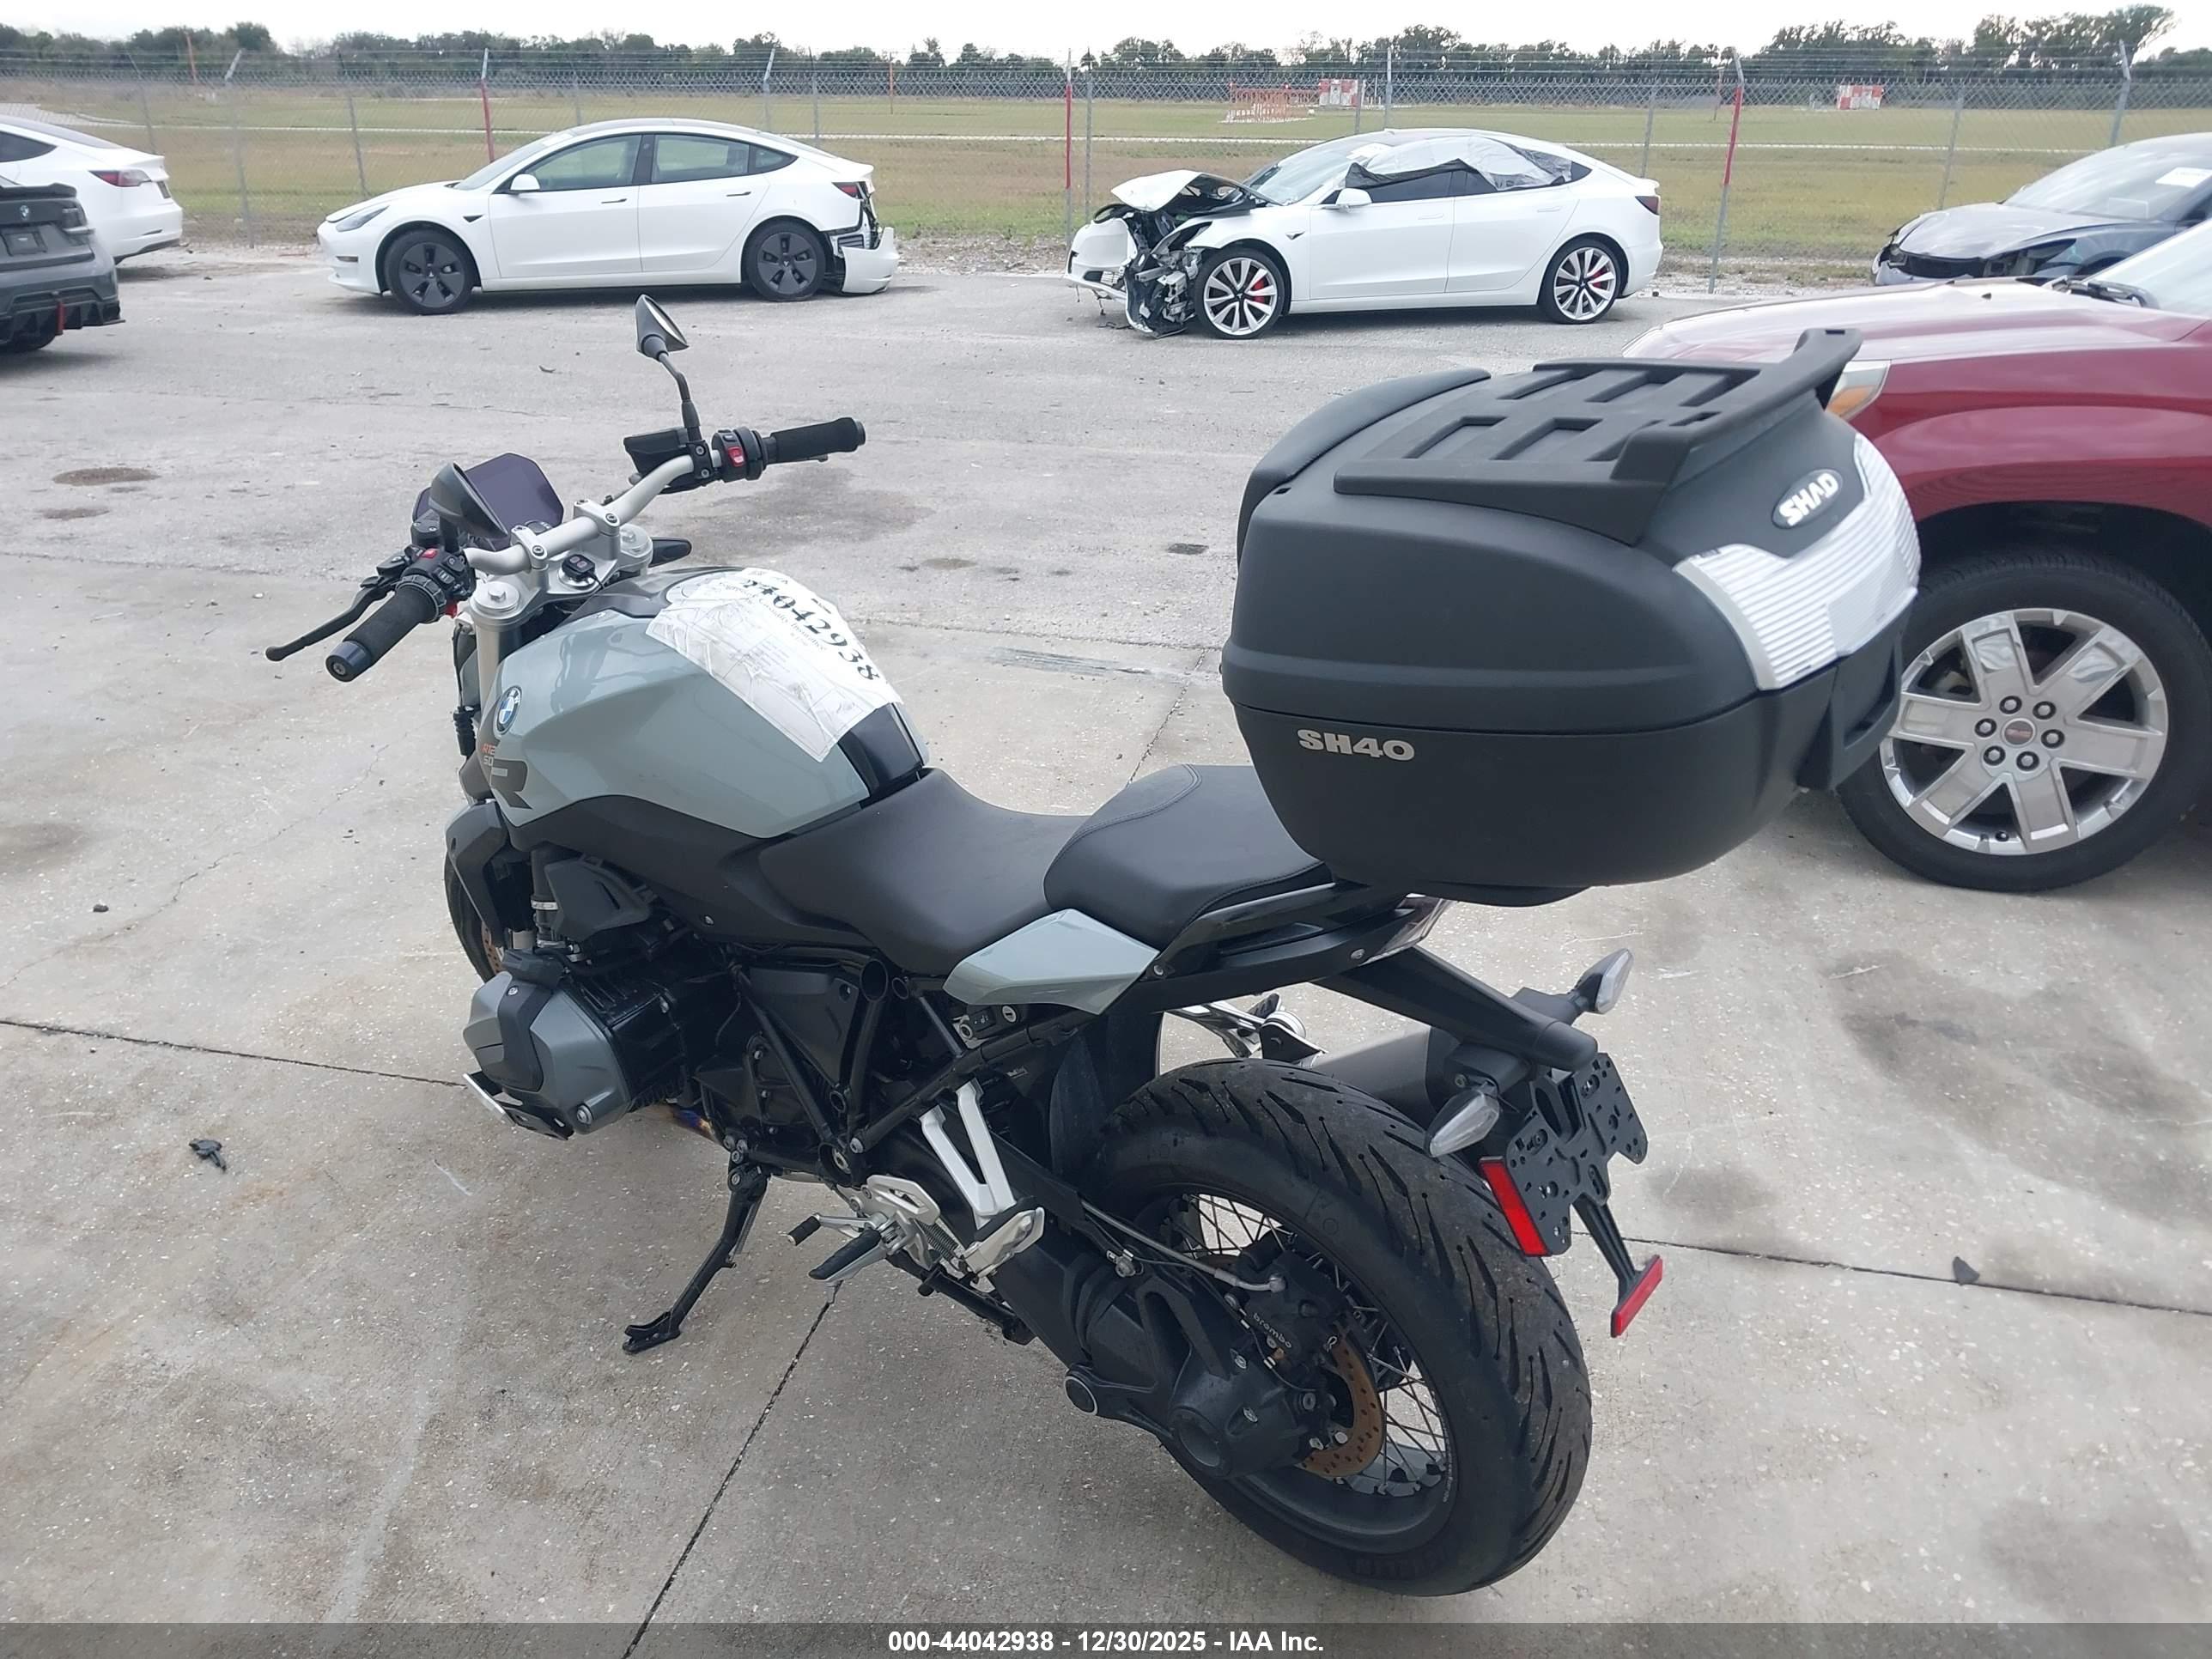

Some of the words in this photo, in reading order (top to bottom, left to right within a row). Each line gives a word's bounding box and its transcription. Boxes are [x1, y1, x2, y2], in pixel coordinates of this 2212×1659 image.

[1779, 472, 1839, 526] SHAD
[1297, 728, 1415, 762] SH40
[1253, 1311, 1292, 1349] brembo
